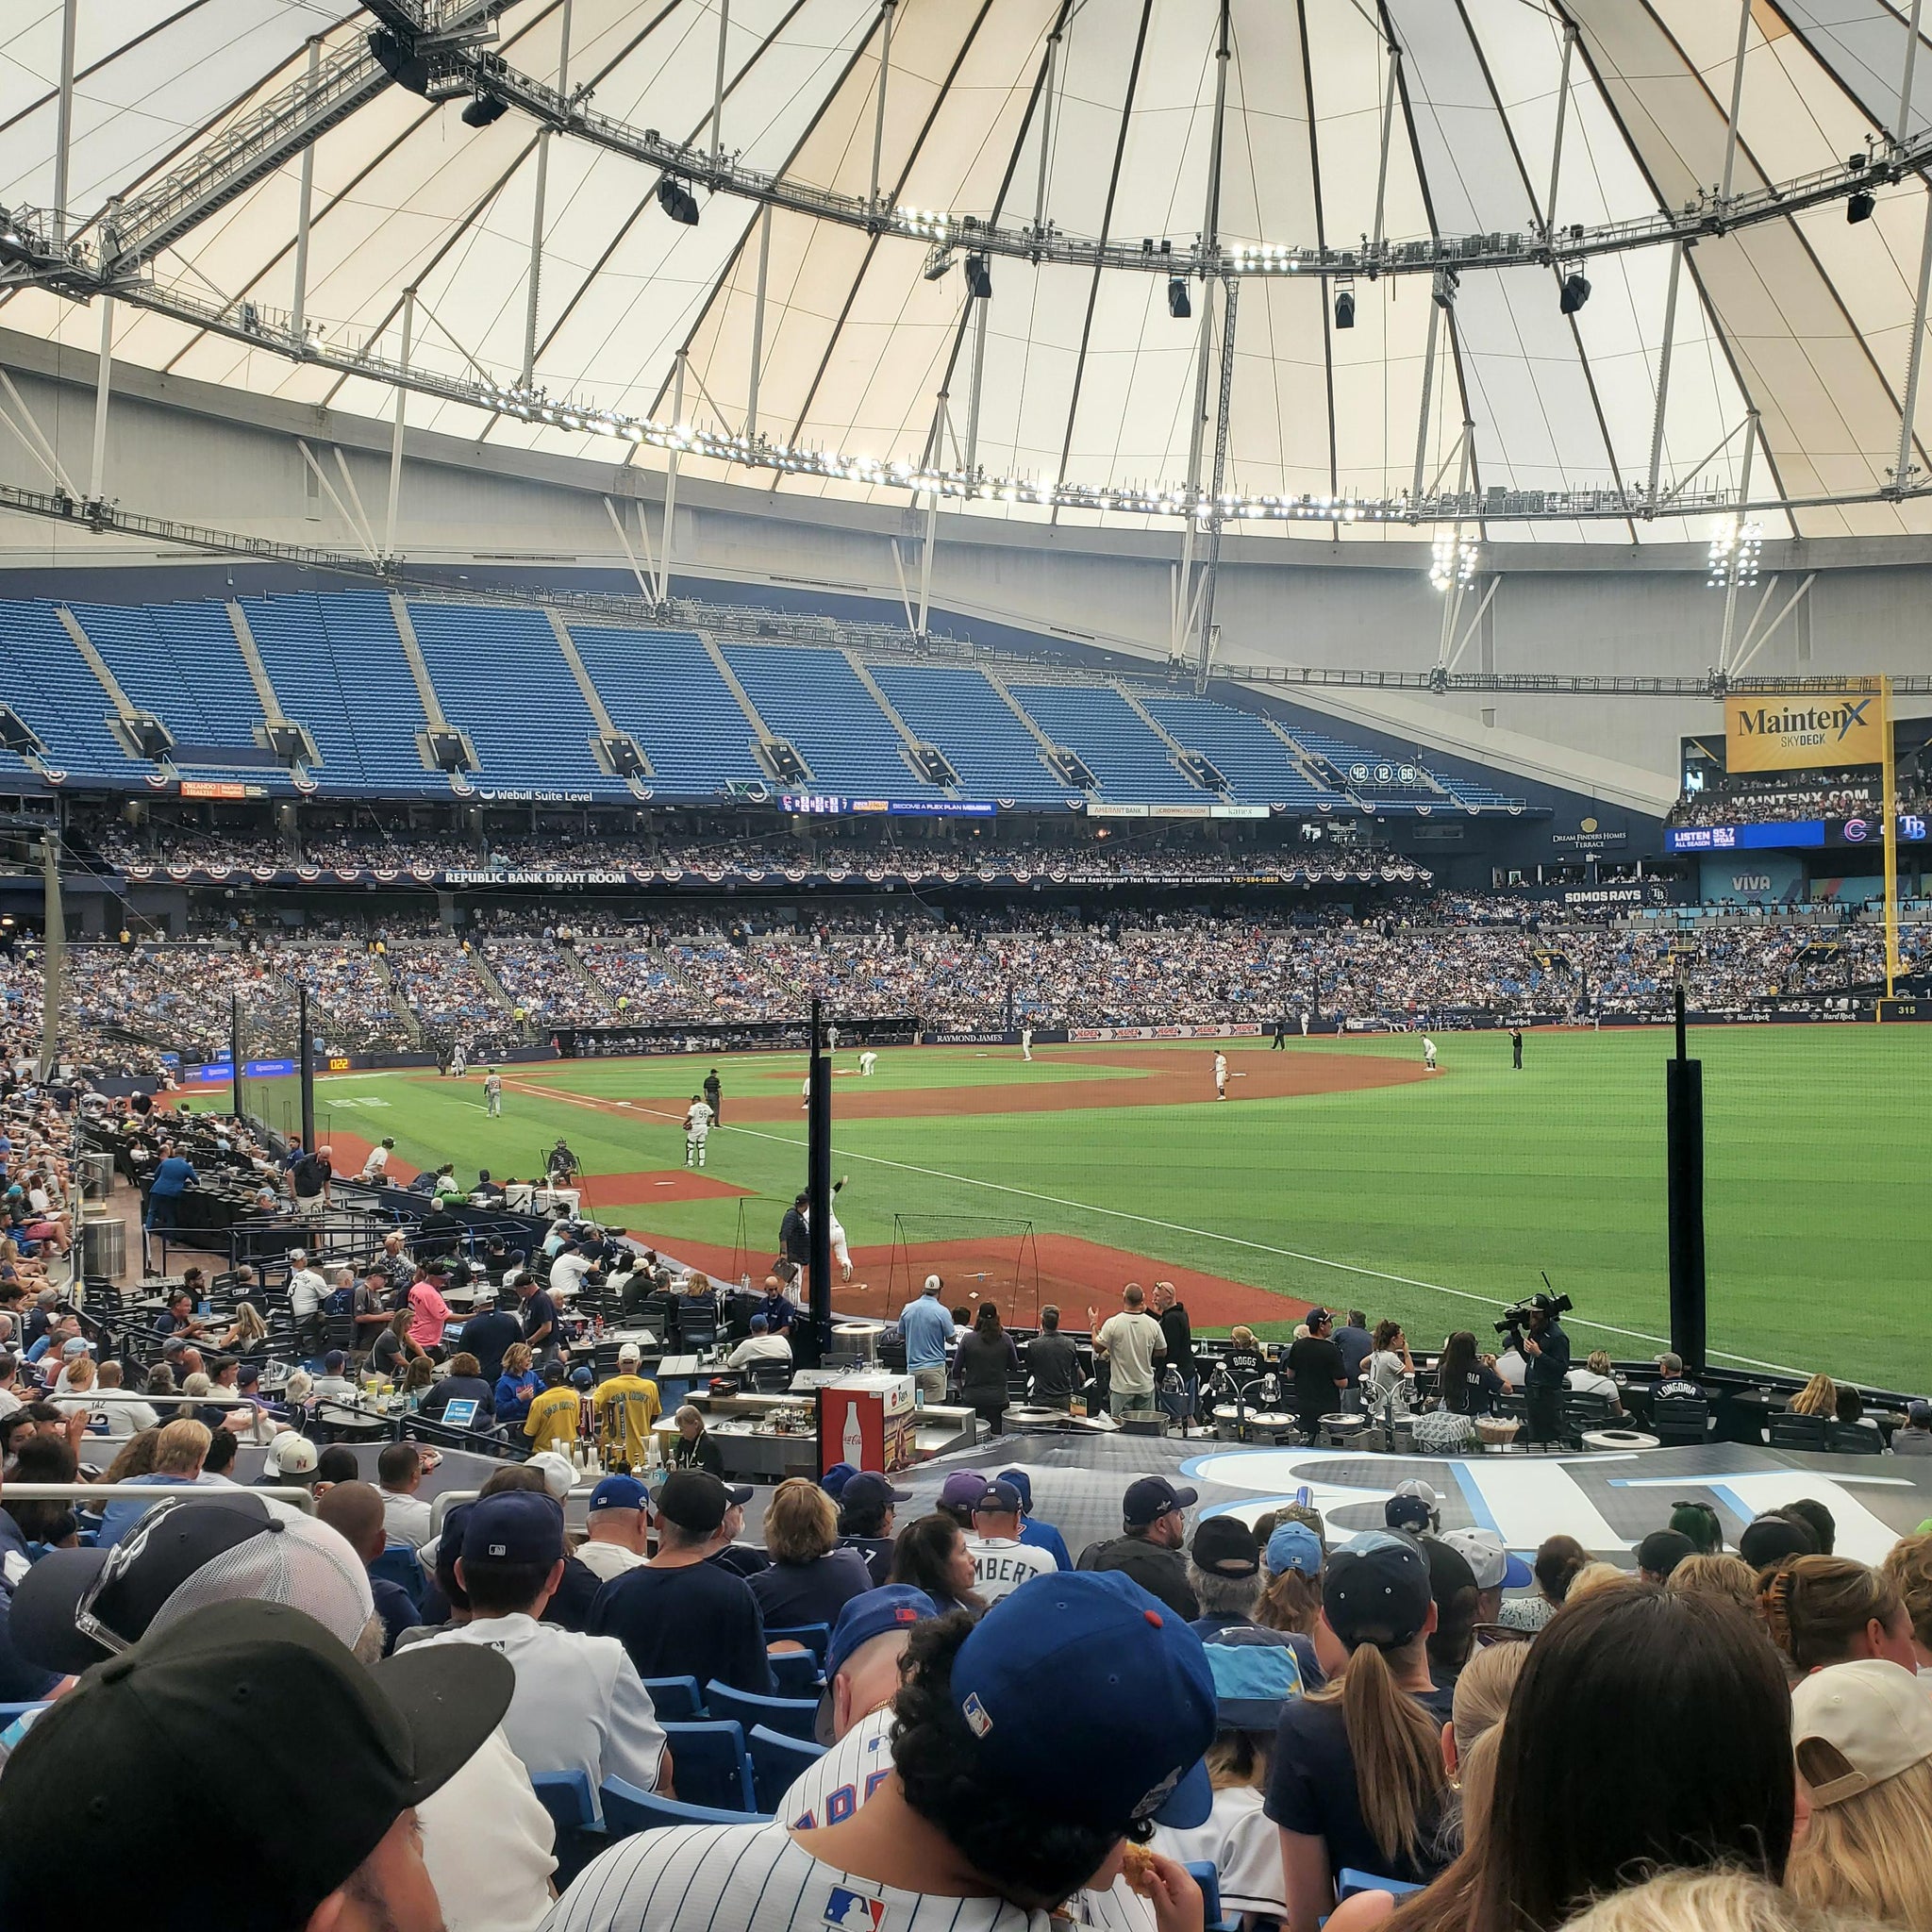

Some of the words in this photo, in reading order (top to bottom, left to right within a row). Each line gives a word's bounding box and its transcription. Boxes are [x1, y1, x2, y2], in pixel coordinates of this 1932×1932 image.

[1781, 733, 1825, 748] SKYDECK
[1352, 765, 1366, 780] 42
[1376, 765, 1391, 781] 12
[1400, 766, 1414, 781] 66
[497, 790, 533, 801] Webull
[534, 791, 564, 802] Suite
[565, 791, 593, 802] Level
[794, 800, 801, 808] R
[810, 800, 815, 808] H
[824, 801, 829, 809] E
[1712, 828, 1735, 838] 95.7
[1844, 819, 1867, 841] C
[1900, 815, 1925, 840] TB
[1553, 833, 1575, 842] DREAM
[1674, 831, 1710, 841] LISTEN
[1574, 841, 1605, 849] TERRACE
[445, 873, 505, 884] REPUBLIC
[508, 873, 543, 883] BANK
[544, 872, 587, 883] DRAFT
[588, 872, 626, 884] ROOM
[1732, 876, 1770, 891] VIVA
[1565, 891, 1608, 903] SOMOS
[1609, 890, 1641, 901] RAYS
[1754, 1013, 1770, 1022] Rock
[1840, 1012, 1856, 1021] Rock
[331, 1058, 347, 1070] 022
[1233, 1357, 1257, 1366] BOGGS
[1657, 1382, 1696, 1398] LONGORIA
